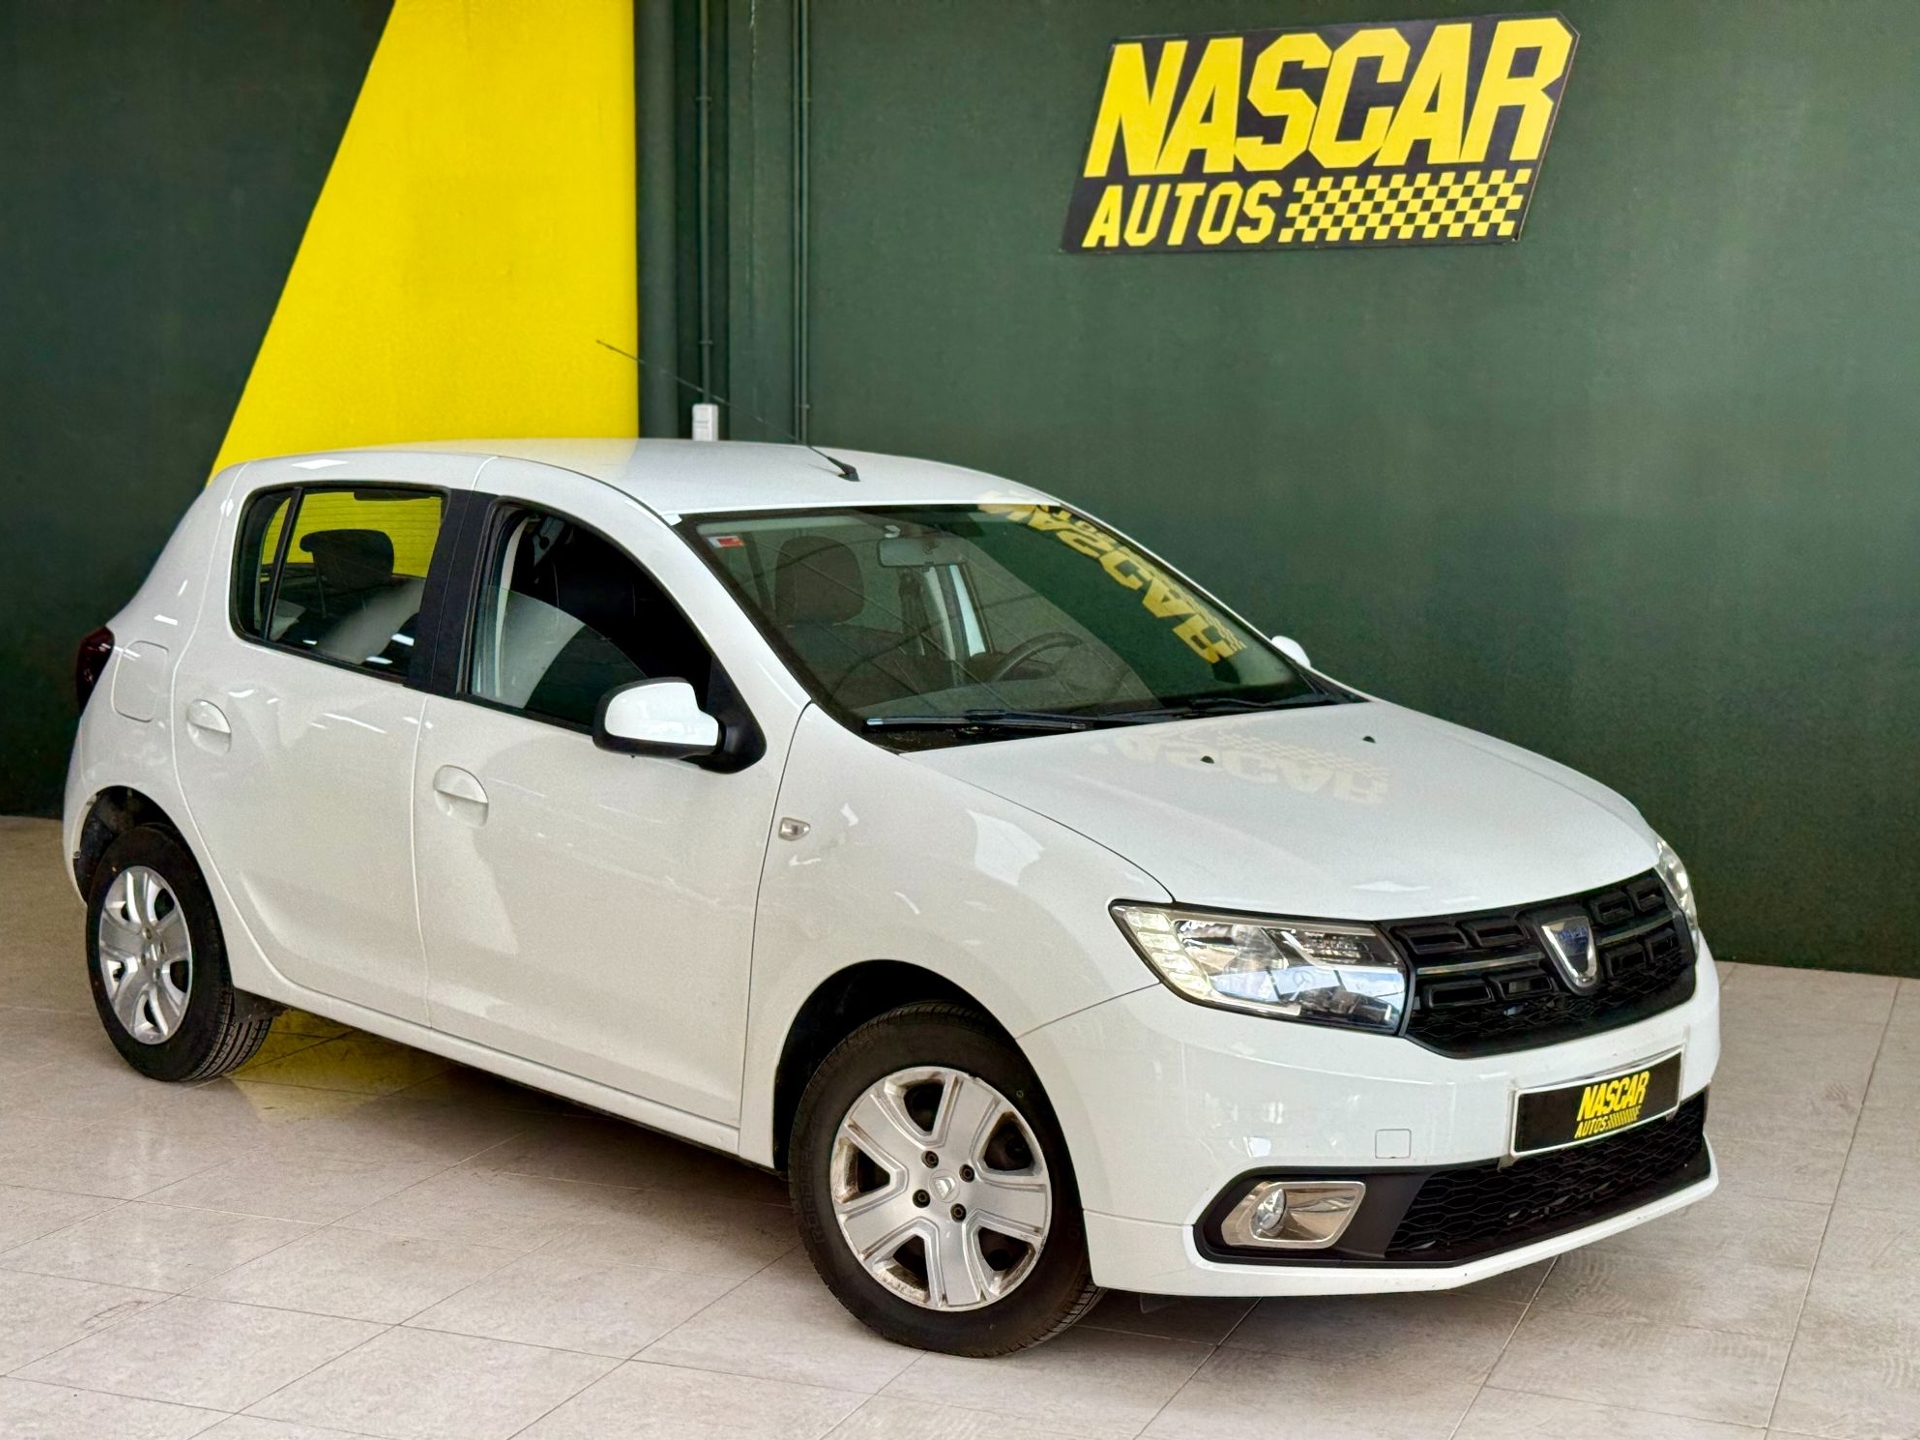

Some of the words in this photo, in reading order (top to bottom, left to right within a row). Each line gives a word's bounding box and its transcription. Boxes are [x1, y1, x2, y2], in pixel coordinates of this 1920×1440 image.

[1084, 18, 1573, 178] NASCAR
[1082, 182, 1283, 248] AUTOS
[1576, 1070, 1650, 1122] NASCAR
[1573, 1115, 1609, 1139] AUTOS
